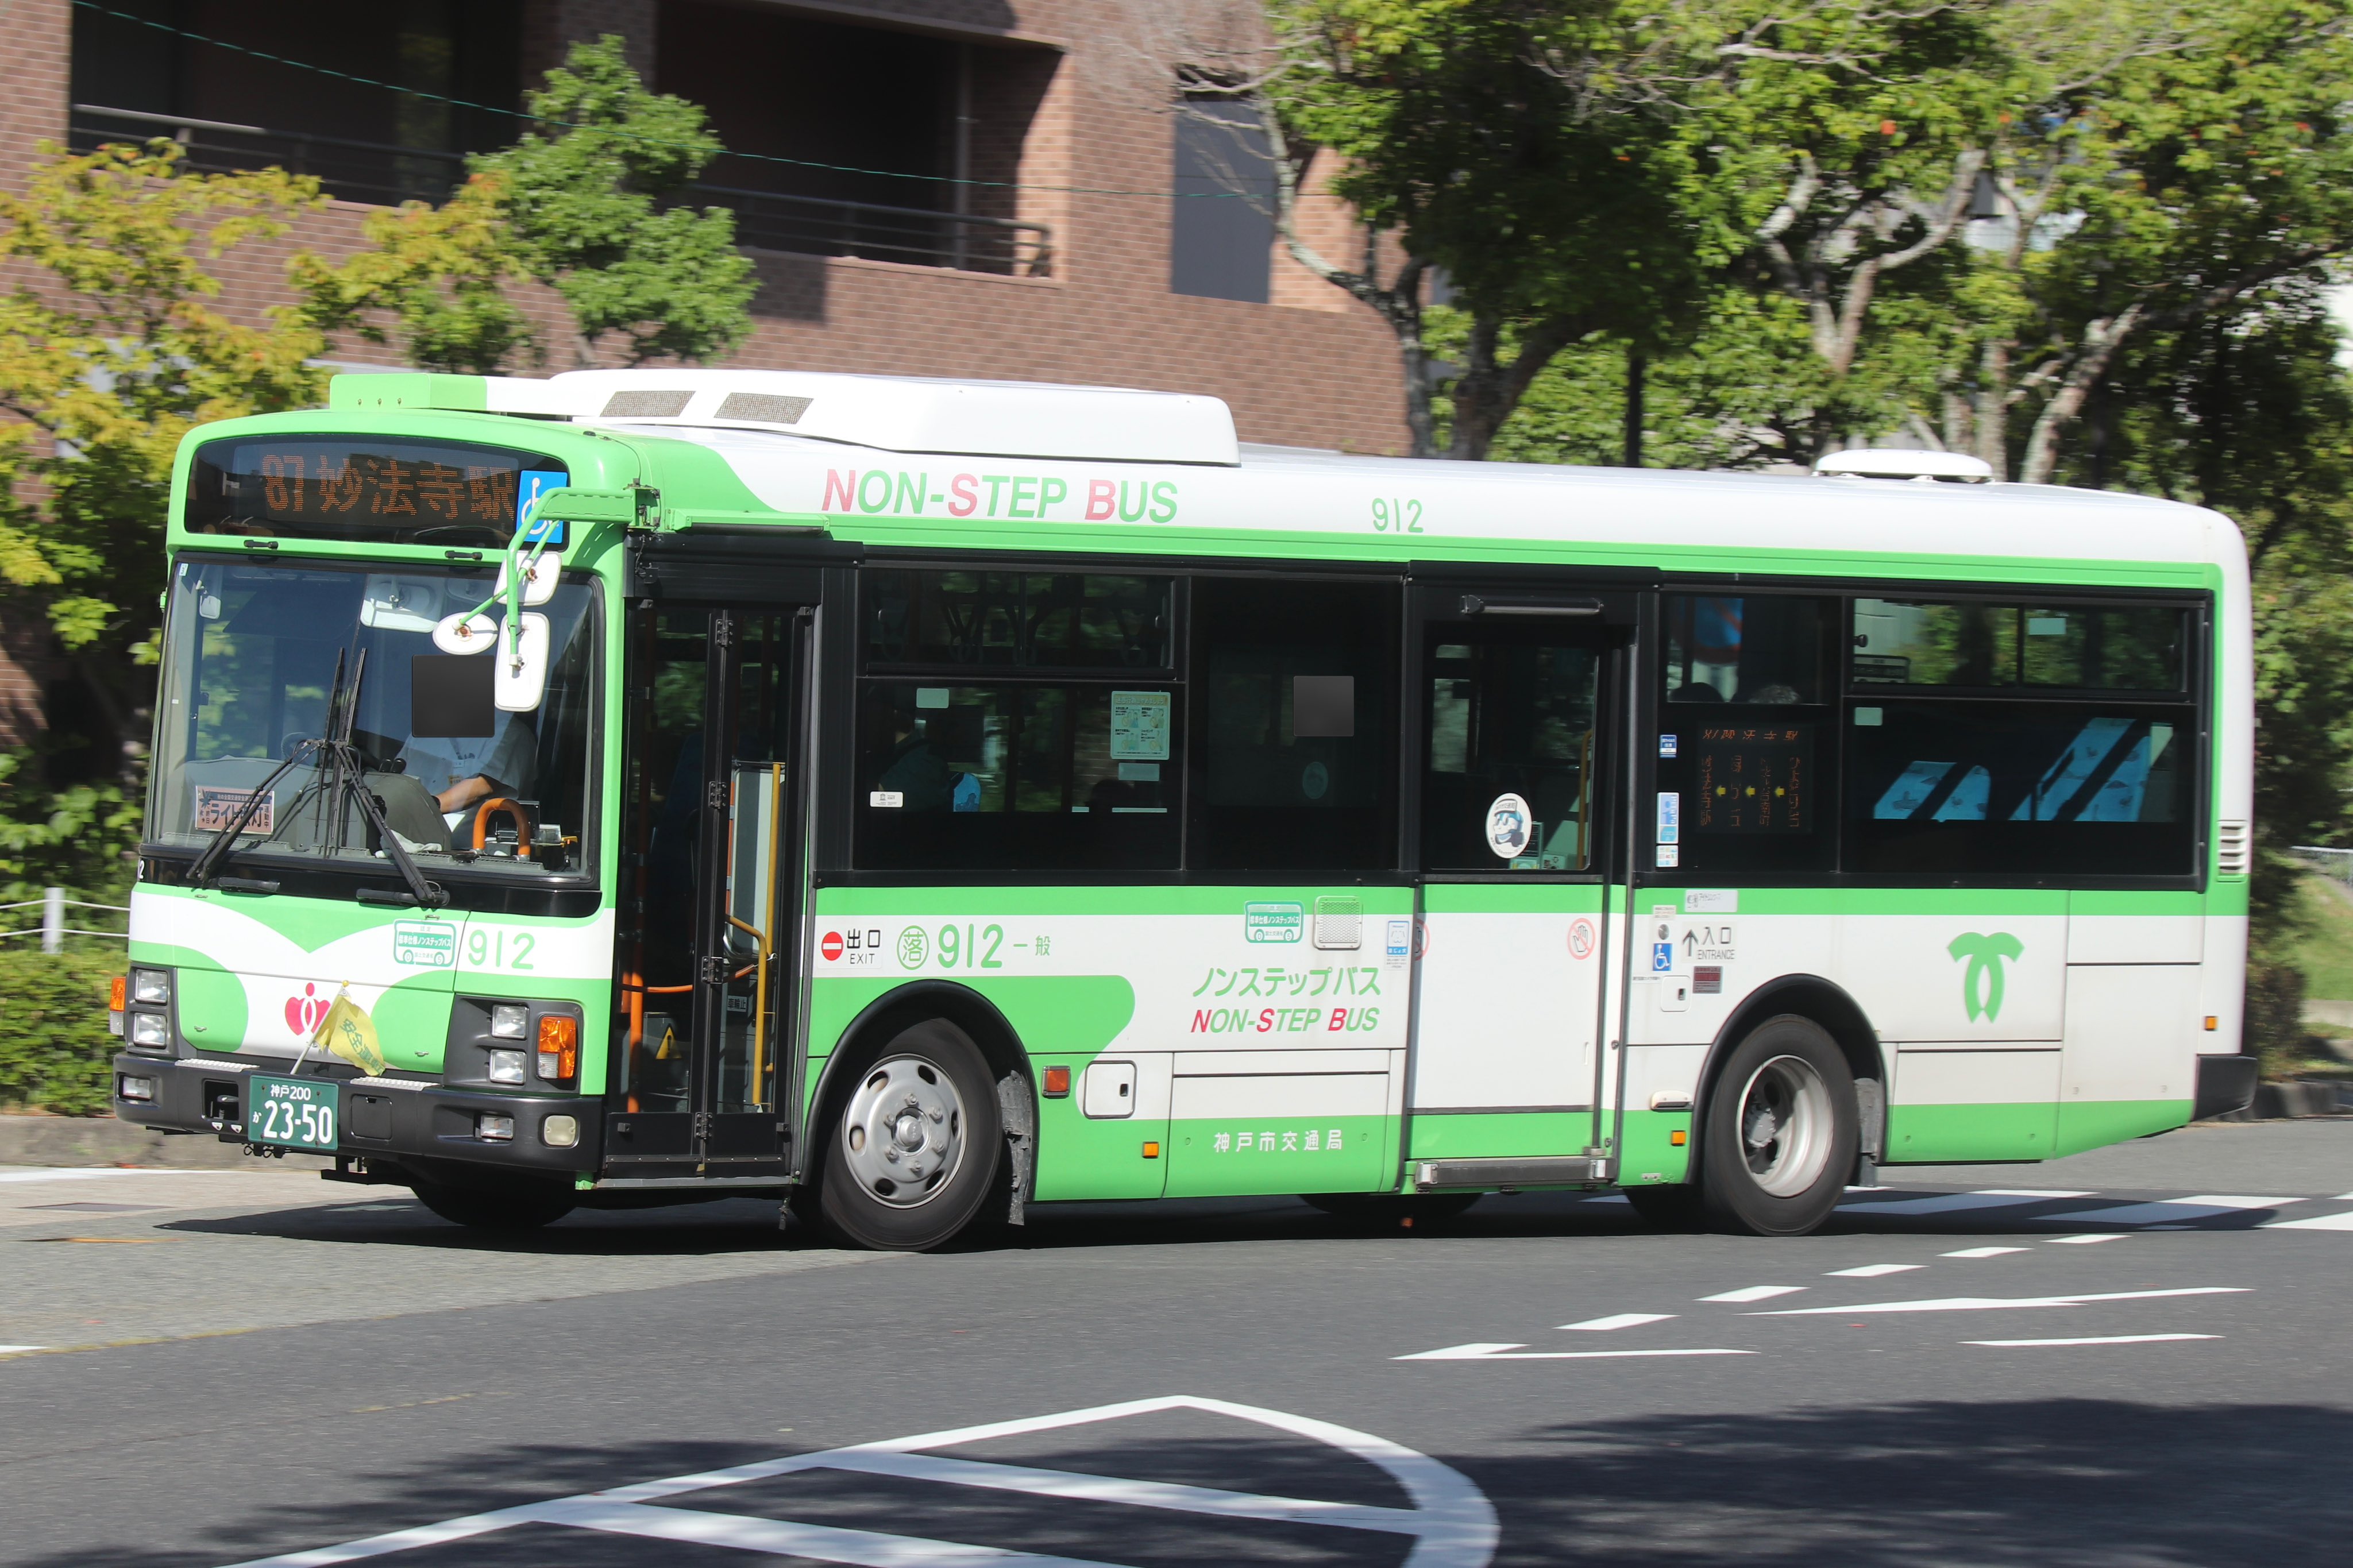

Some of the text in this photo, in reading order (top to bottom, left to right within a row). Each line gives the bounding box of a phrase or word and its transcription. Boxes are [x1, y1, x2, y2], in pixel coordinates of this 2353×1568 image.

[263, 454, 515, 520] 87 妙法寺駅
[821, 469, 1178, 524] NON-STEP BUS
[1372, 497, 1424, 533] 912
[468, 929, 534, 970] 912
[847, 928, 881, 949] 出口
[900, 928, 926, 965] 落
[938, 924, 1004, 968] 912
[1702, 926, 1731, 945] 入口
[850, 953, 875, 964] EXIT
[1698, 949, 1735, 960] ENTRANCE
[1193, 966, 1381, 997] ノンステップバス
[1191, 1007, 1380, 1033] NON-STEP BUS
[253, 1100, 333, 1144] か 23-50
[1213, 1129, 1343, 1153] 神戸市交通局
